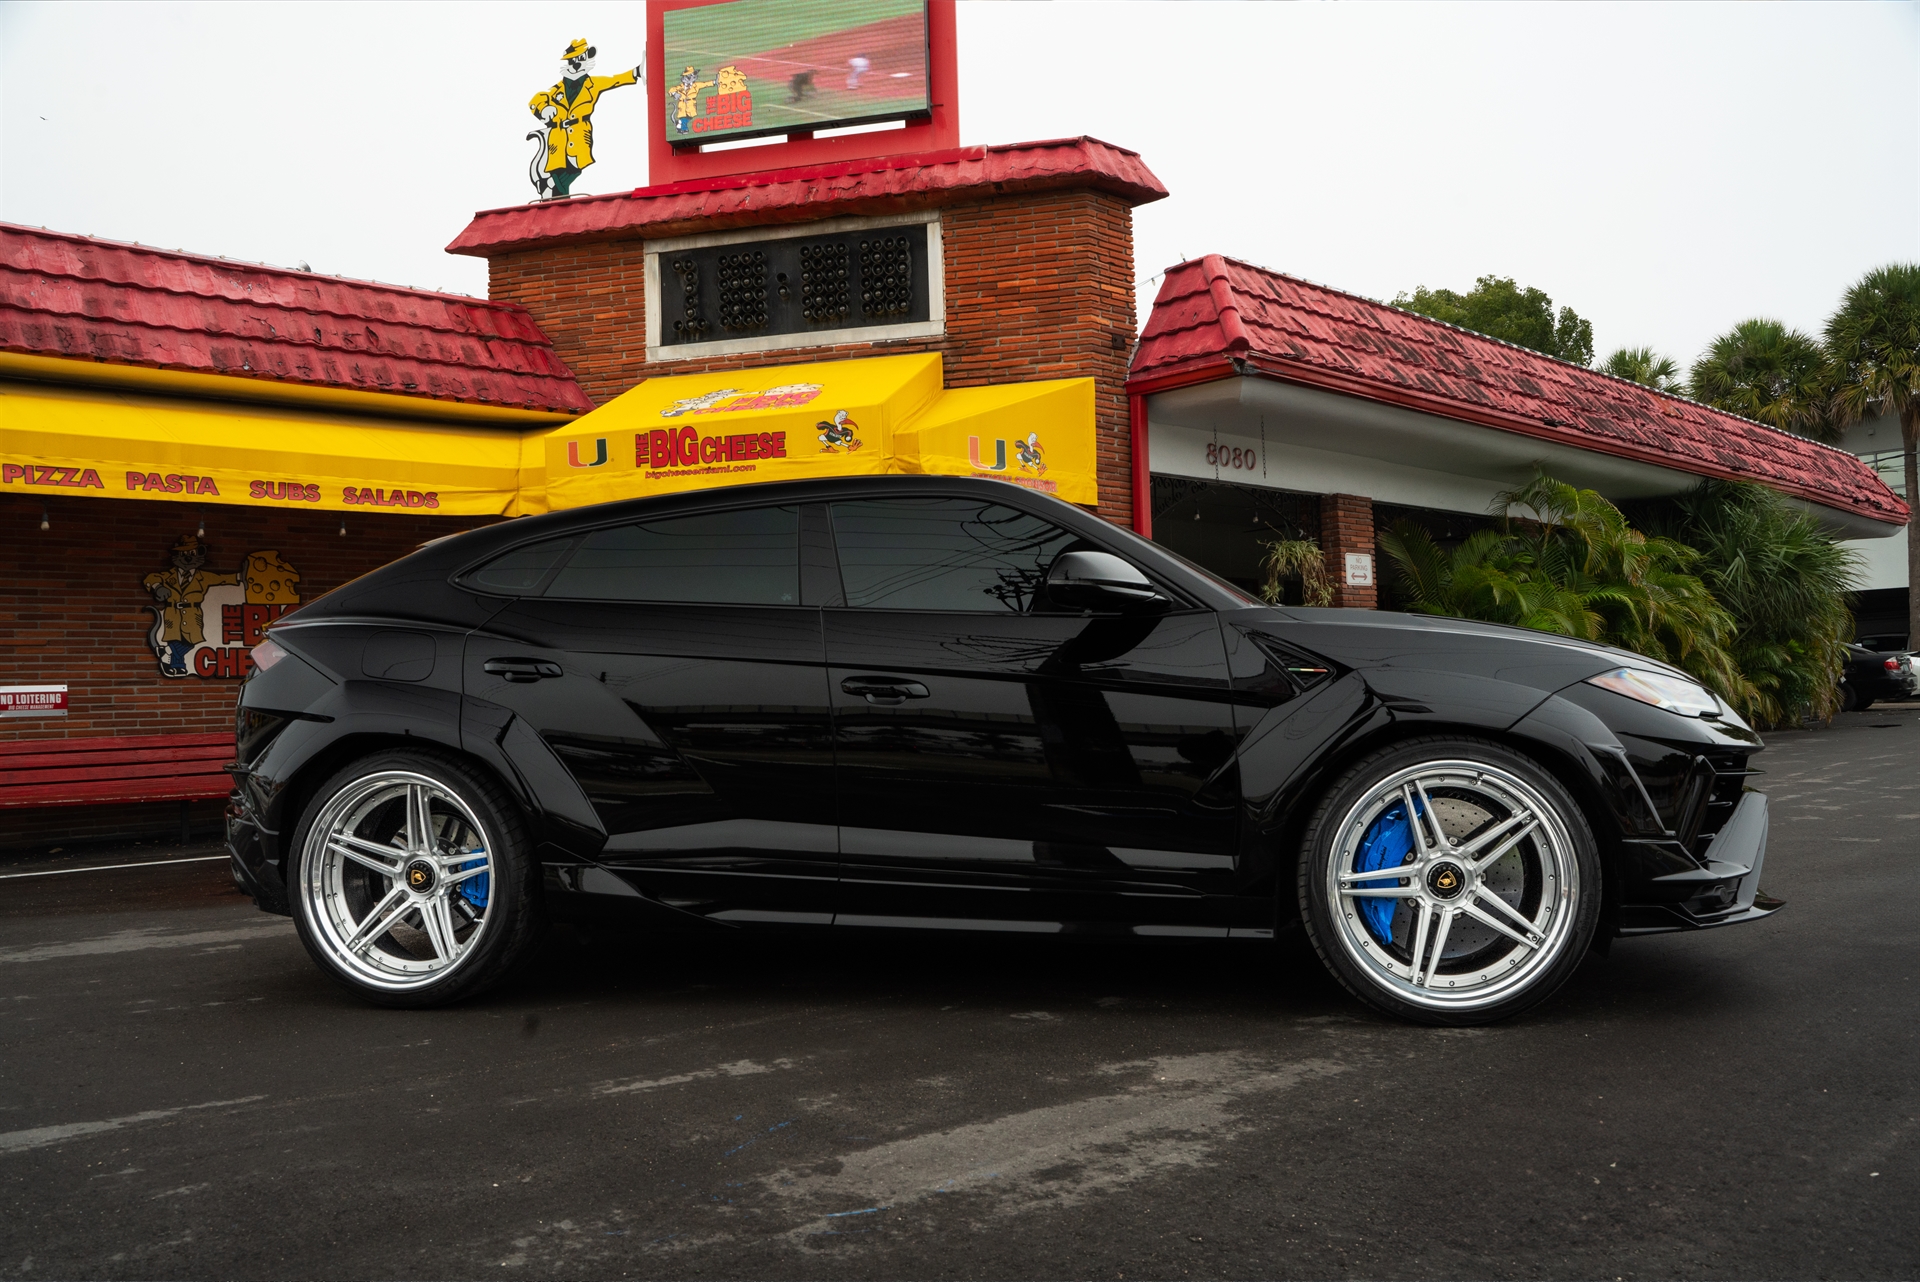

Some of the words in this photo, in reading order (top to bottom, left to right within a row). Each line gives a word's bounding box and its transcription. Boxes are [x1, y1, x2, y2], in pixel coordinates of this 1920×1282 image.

[706, 95, 717, 115] THE
[717, 90, 752, 115] BIG
[692, 112, 753, 133] CHEESE
[635, 433, 650, 467] THE
[650, 426, 699, 468] BIG
[700, 431, 787, 463] CHEESE
[1206, 443, 1256, 470] 8080
[645, 464, 756, 479] bigcheesemiami.com
[2, 464, 105, 489] PIZZA
[125, 471, 220, 496] PASTA
[249, 480, 321, 502] SUBS
[342, 486, 440, 509] SALADS
[221, 604, 242, 645] THE
[194, 646, 254, 677] CHE
[0, 694, 13, 705] NO
[15, 693, 62, 704] LOITERING
